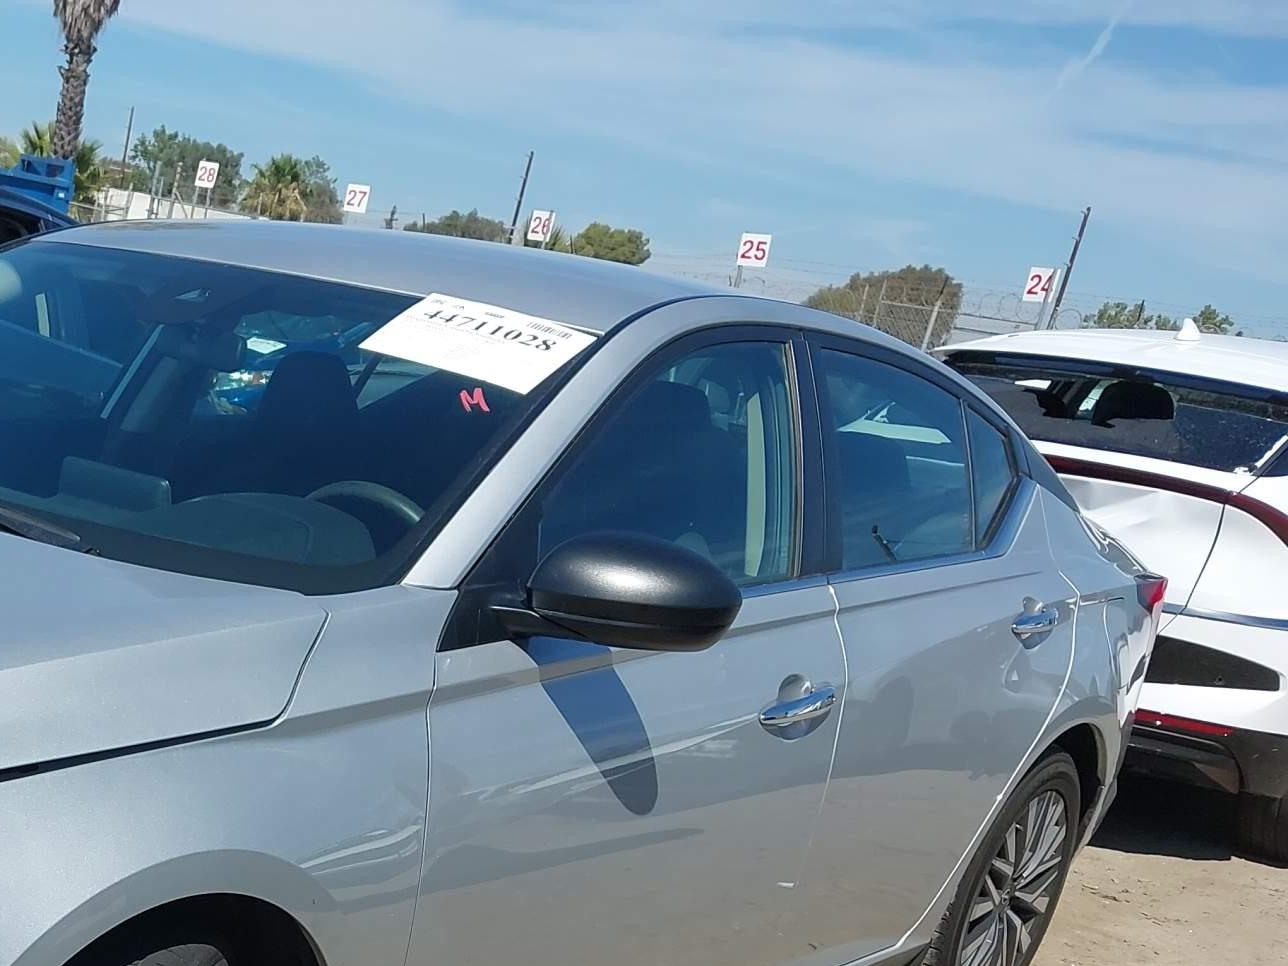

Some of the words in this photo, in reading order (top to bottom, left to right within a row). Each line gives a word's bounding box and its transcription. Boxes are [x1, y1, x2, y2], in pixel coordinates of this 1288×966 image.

[198, 166, 216, 182] 28
[346, 189, 368, 208] 27
[531, 216, 551, 235] 26
[740, 240, 768, 260] 25
[1026, 274, 1053, 295] 24
[424, 309, 557, 352] 44711028
[459, 387, 490, 413] M
